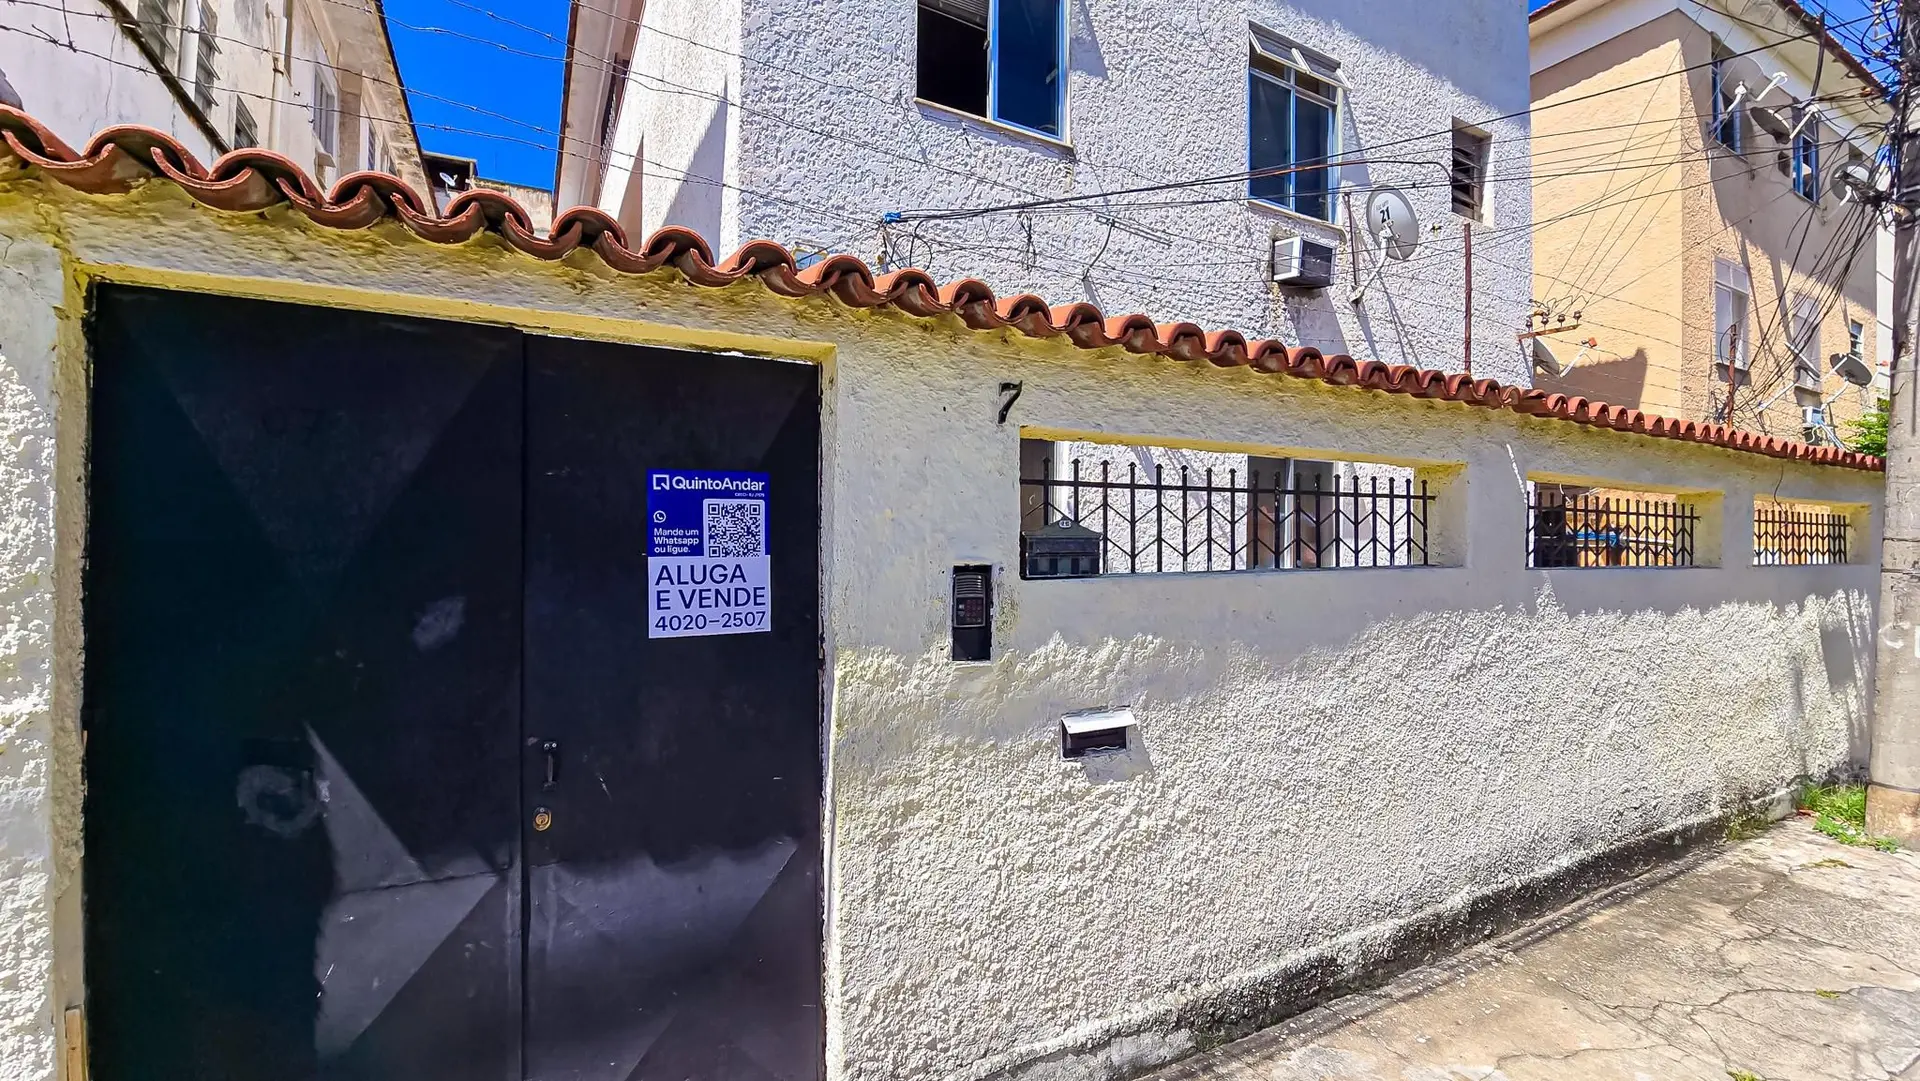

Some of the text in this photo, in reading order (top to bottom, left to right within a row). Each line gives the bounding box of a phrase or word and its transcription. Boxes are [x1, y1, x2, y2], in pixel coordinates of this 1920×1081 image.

[998, 380, 1022, 424] 7
[672, 476, 765, 491] QuintoAndar
[654, 528, 684, 536] Mande
[654, 537, 699, 546] Whatsapp
[667, 545, 691, 555] ligue.
[655, 564, 747, 586] ALUGA
[656, 587, 766, 610] E VENDE
[655, 611, 766, 631] 4020-2507
